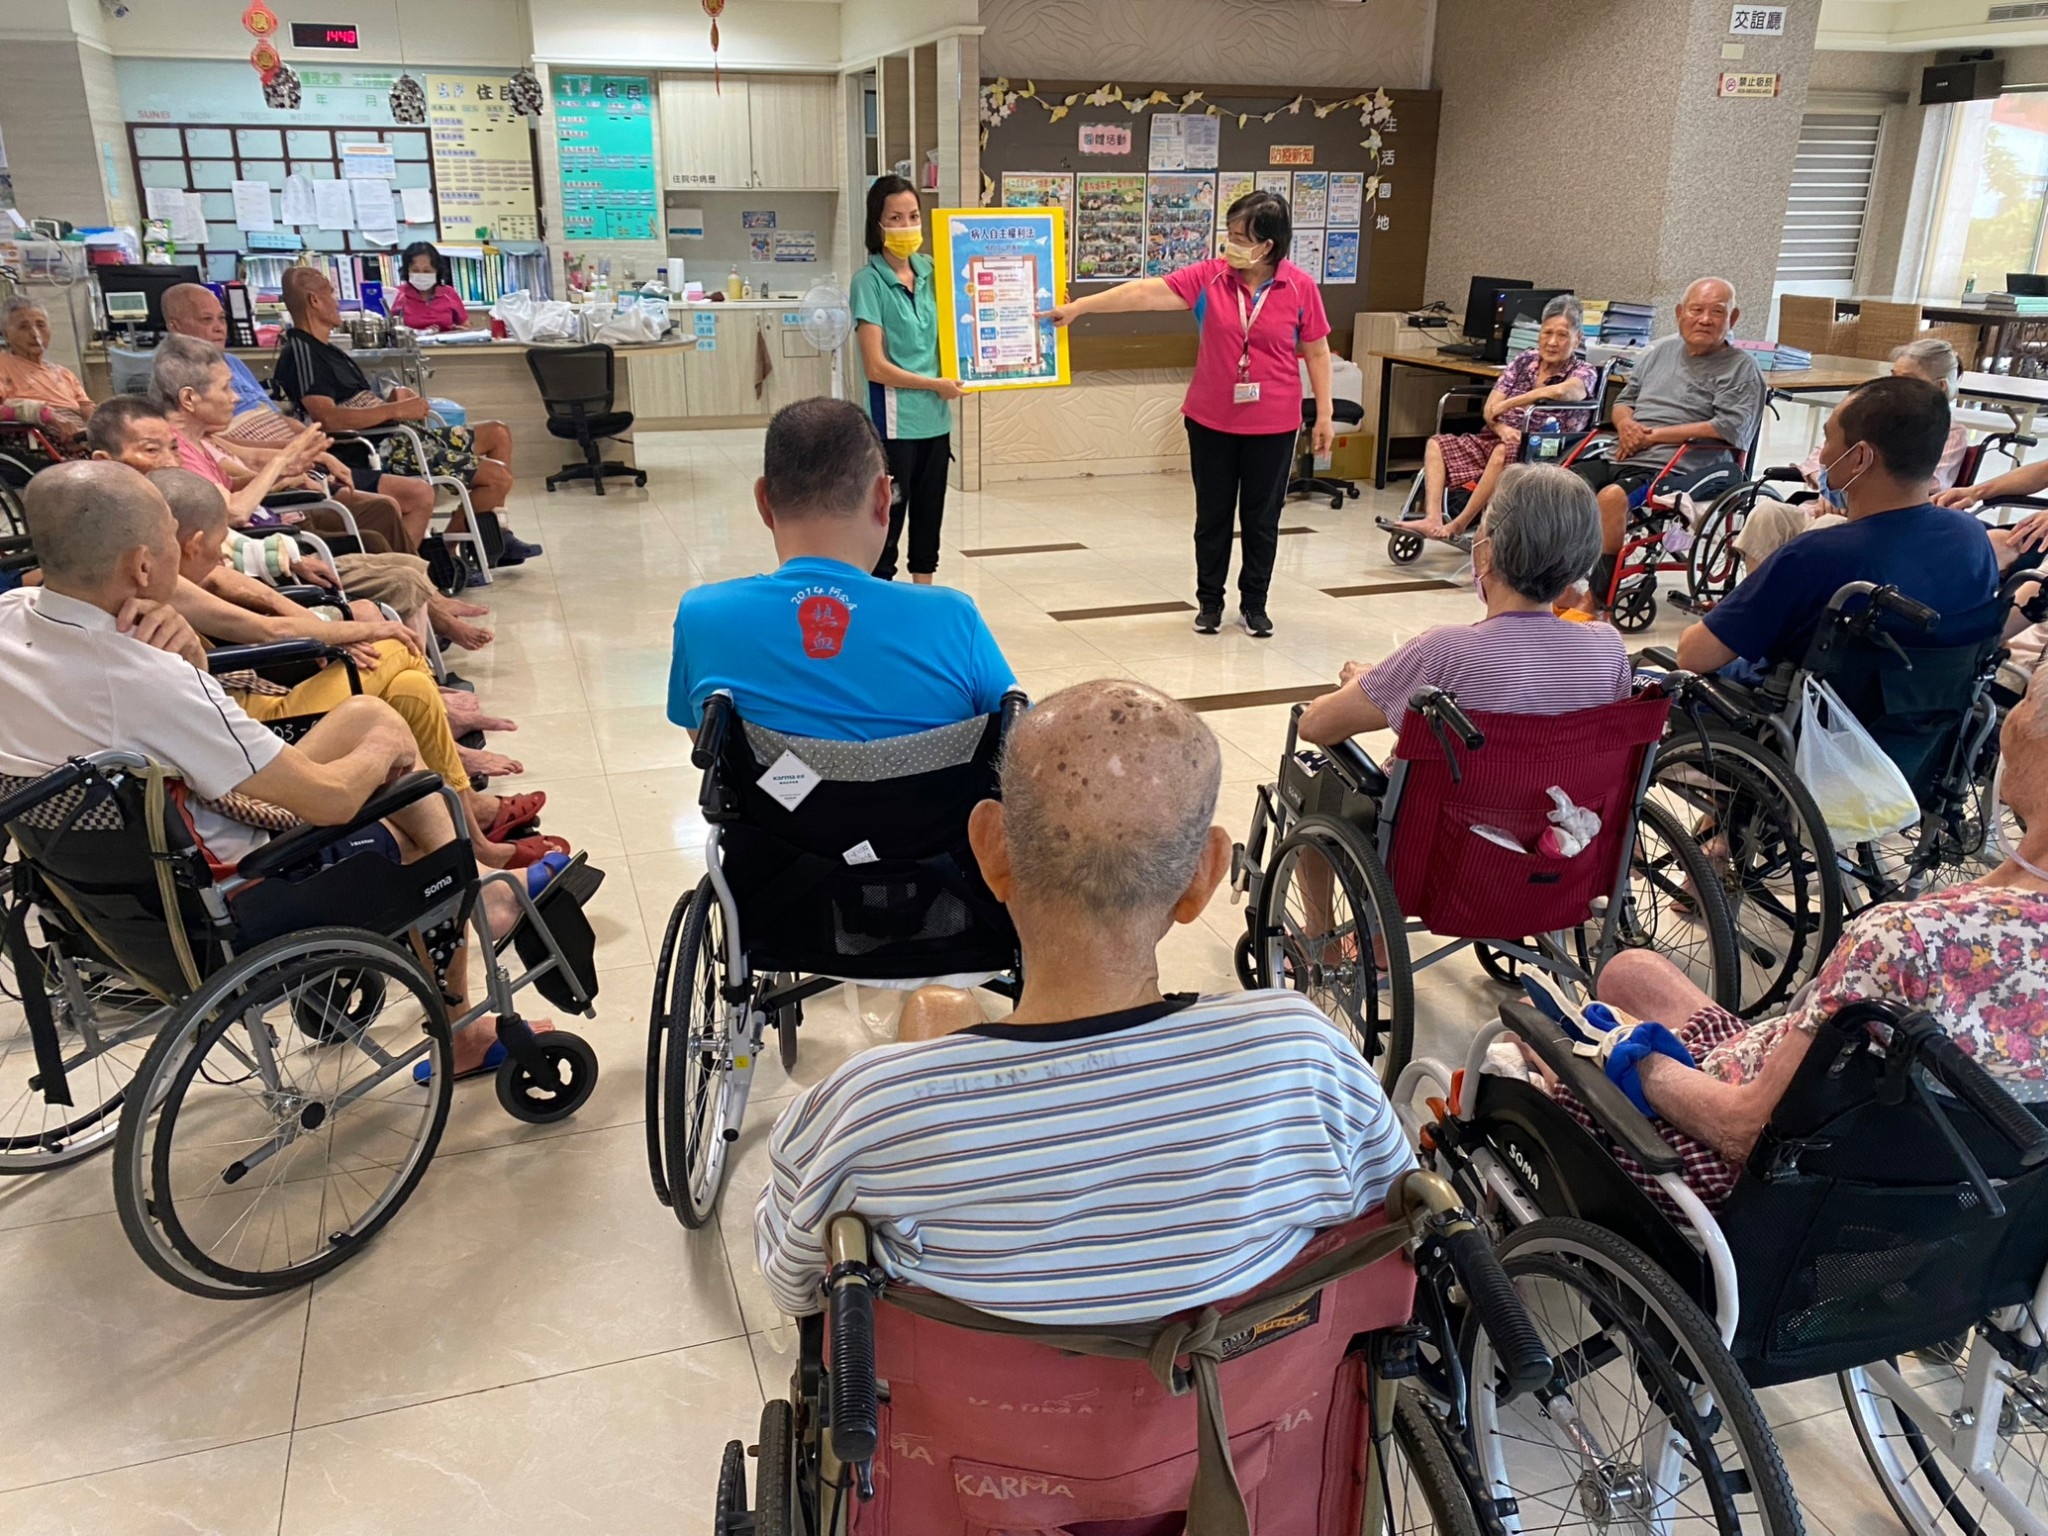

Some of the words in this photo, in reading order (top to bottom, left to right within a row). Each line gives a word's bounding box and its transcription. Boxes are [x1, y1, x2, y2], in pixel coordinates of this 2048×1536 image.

[1733, 10, 1783, 30] 交誼廳
[1083, 132, 1127, 146] 團體活動
[1271, 147, 1313, 163] 防疫新知
[672, 174, 717, 184] 住院中病歷
[971, 227, 1035, 240] 病人自主權利法
[790, 586, 825, 605] 2014
[424, 875, 453, 897] soma
[1508, 1143, 1540, 1190] SOMA
[955, 1473, 1075, 1500] KARMA
